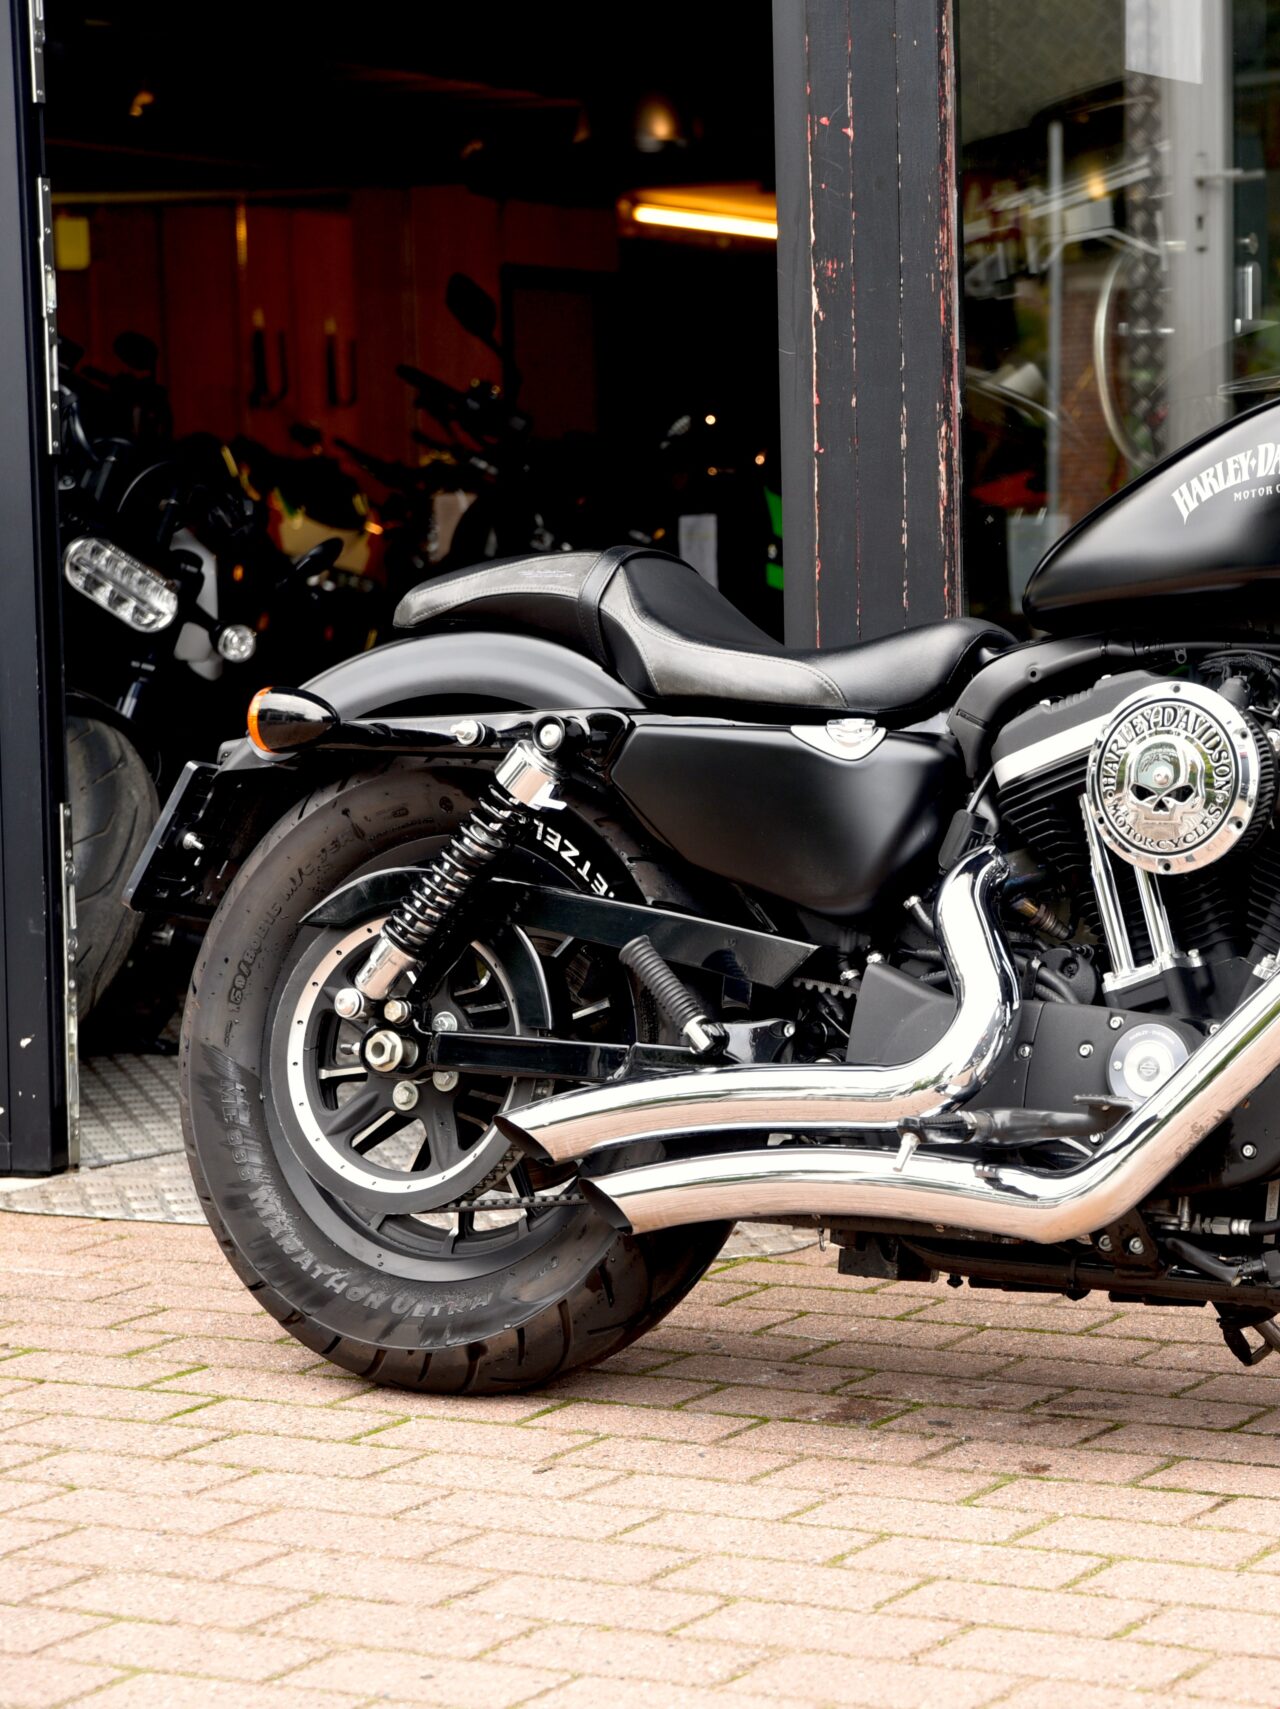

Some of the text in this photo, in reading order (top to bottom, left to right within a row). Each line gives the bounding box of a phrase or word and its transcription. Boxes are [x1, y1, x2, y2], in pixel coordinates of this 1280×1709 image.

[1232, 484, 1274, 503] MOTOR
[1107, 799, 1224, 850] MOTORCYCLES
[391, 1291, 495, 1319] ULTRA
